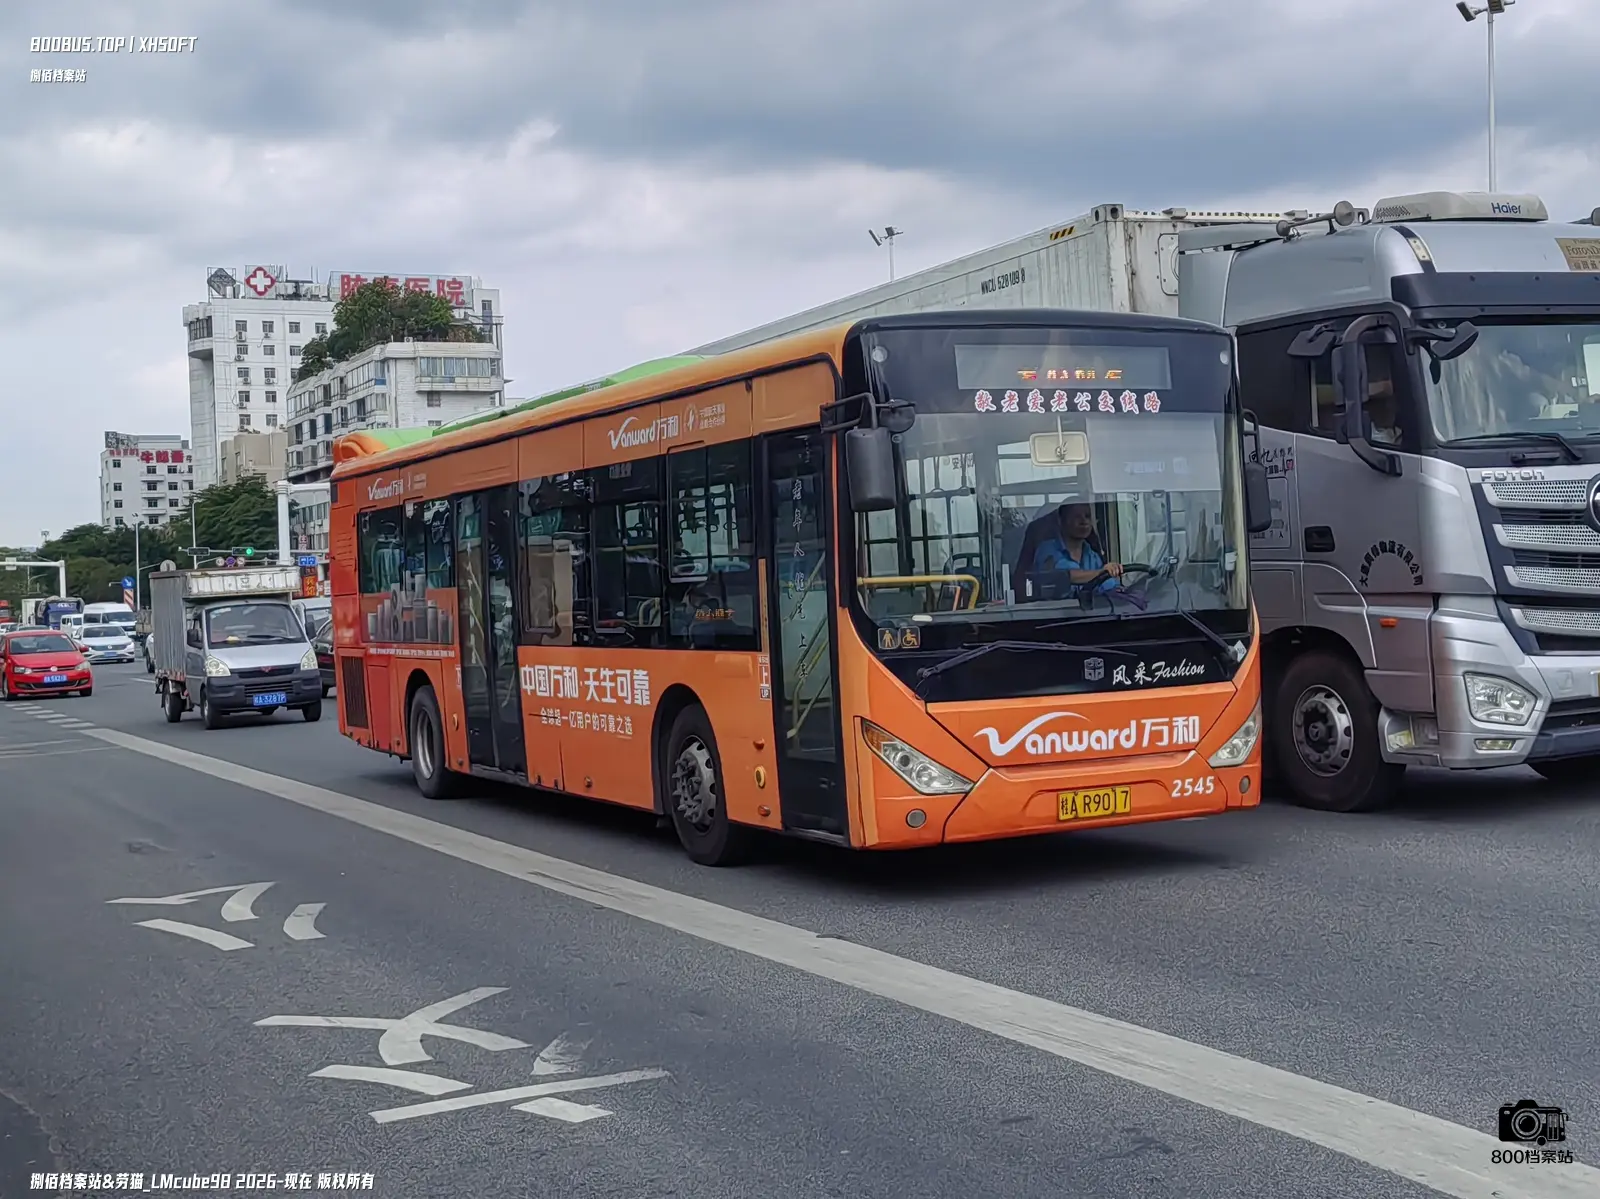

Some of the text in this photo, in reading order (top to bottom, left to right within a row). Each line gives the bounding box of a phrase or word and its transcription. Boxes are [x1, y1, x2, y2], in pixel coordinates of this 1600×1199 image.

[1491, 202, 1521, 214] Haier
[975, 389, 1161, 414] 敬老爱老公交线路
[657, 415, 679, 440] 万和
[1481, 469, 1545, 482] FOTON
[1112, 658, 1205, 685] 风采 Fashion
[974, 712, 1200, 757] Vanward 万和
[1172, 776, 1215, 798] 2545
